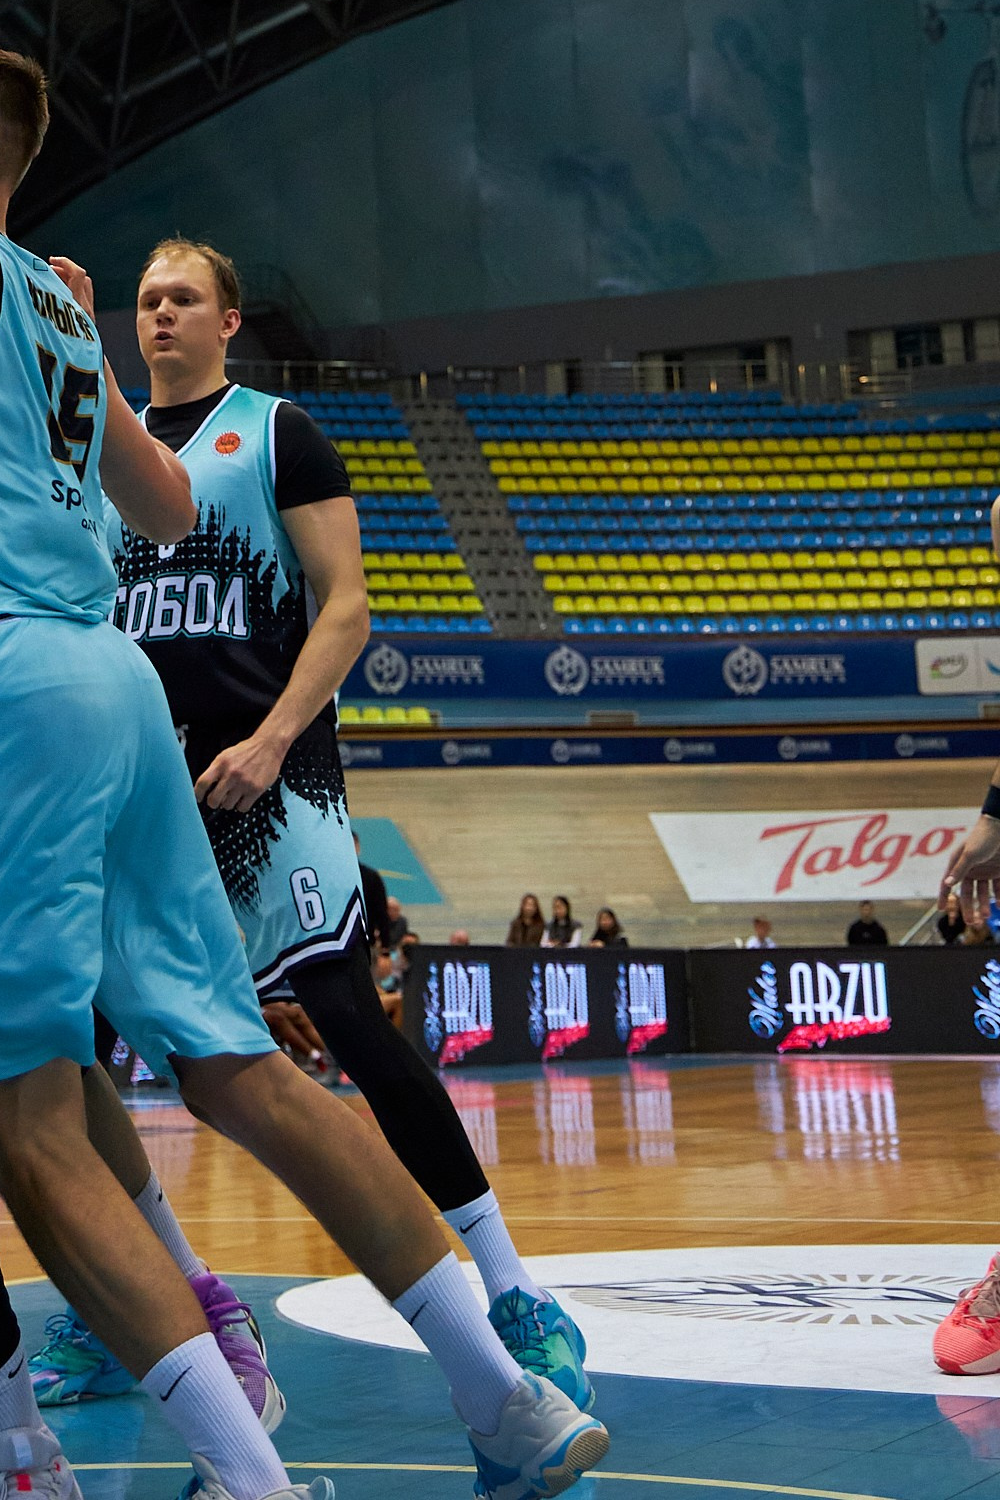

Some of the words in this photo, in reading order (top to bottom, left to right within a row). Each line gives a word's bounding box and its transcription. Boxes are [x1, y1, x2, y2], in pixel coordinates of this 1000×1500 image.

[759, 812, 967, 896] Talgo
[289, 866, 327, 932] 6
[784, 960, 889, 1025] ARZU
